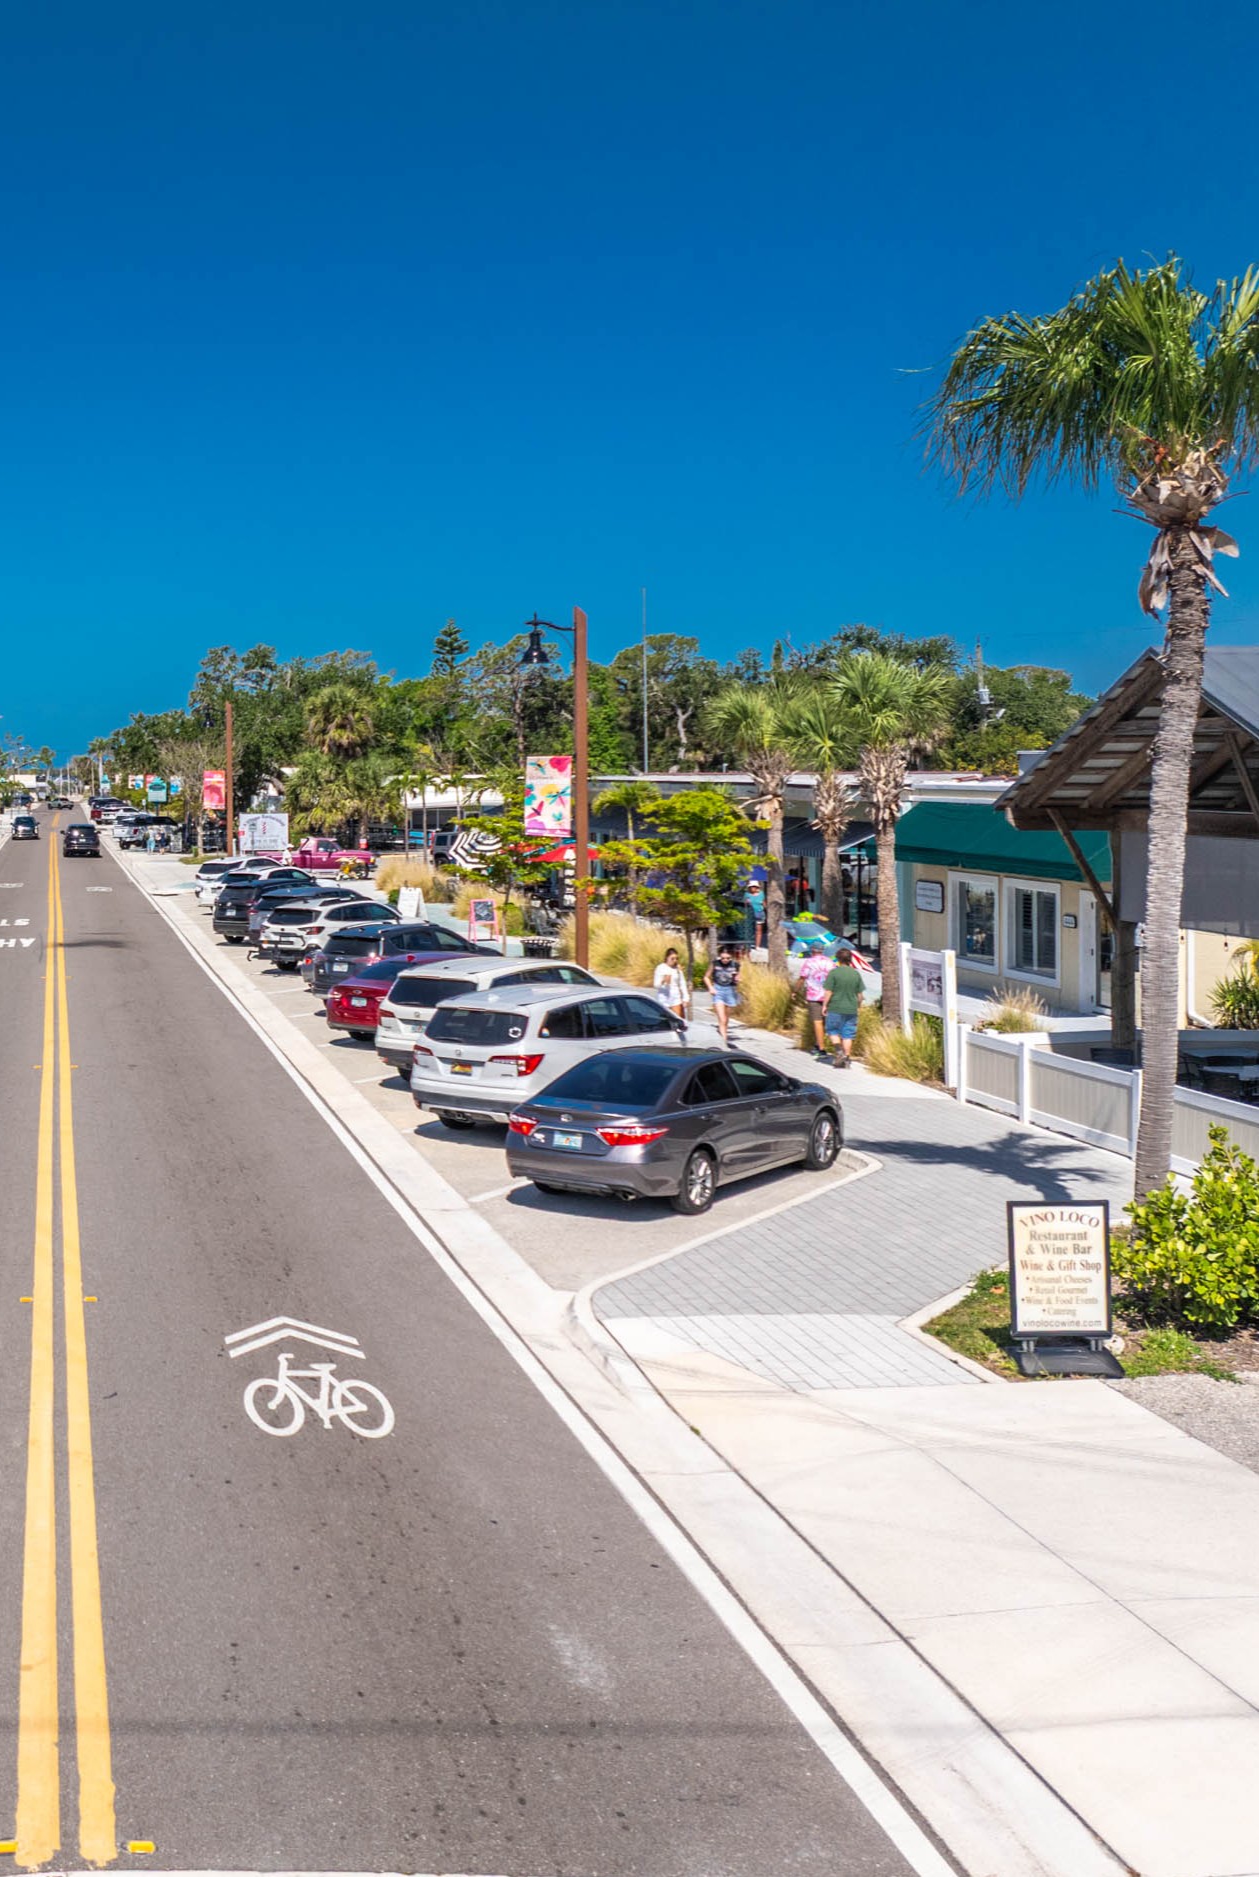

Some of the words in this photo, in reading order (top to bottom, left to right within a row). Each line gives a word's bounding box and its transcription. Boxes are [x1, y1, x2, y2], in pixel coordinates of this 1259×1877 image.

[1019, 1211, 1055, 1228] VINO
[1059, 1210, 1100, 1228] LOCO
[1029, 1230, 1088, 1241] Restaurant
[1025, 1244, 1036, 1255] &
[1040, 1243, 1068, 1255] Wine
[1072, 1243, 1093, 1255] Bar
[1020, 1259, 1044, 1271] Wine
[1046, 1260, 1055, 1271] &
[1058, 1259, 1077, 1271] Gift
[1079, 1259, 1102, 1274] Shop
[1022, 1319, 1102, 1328] vinolocowine.com
